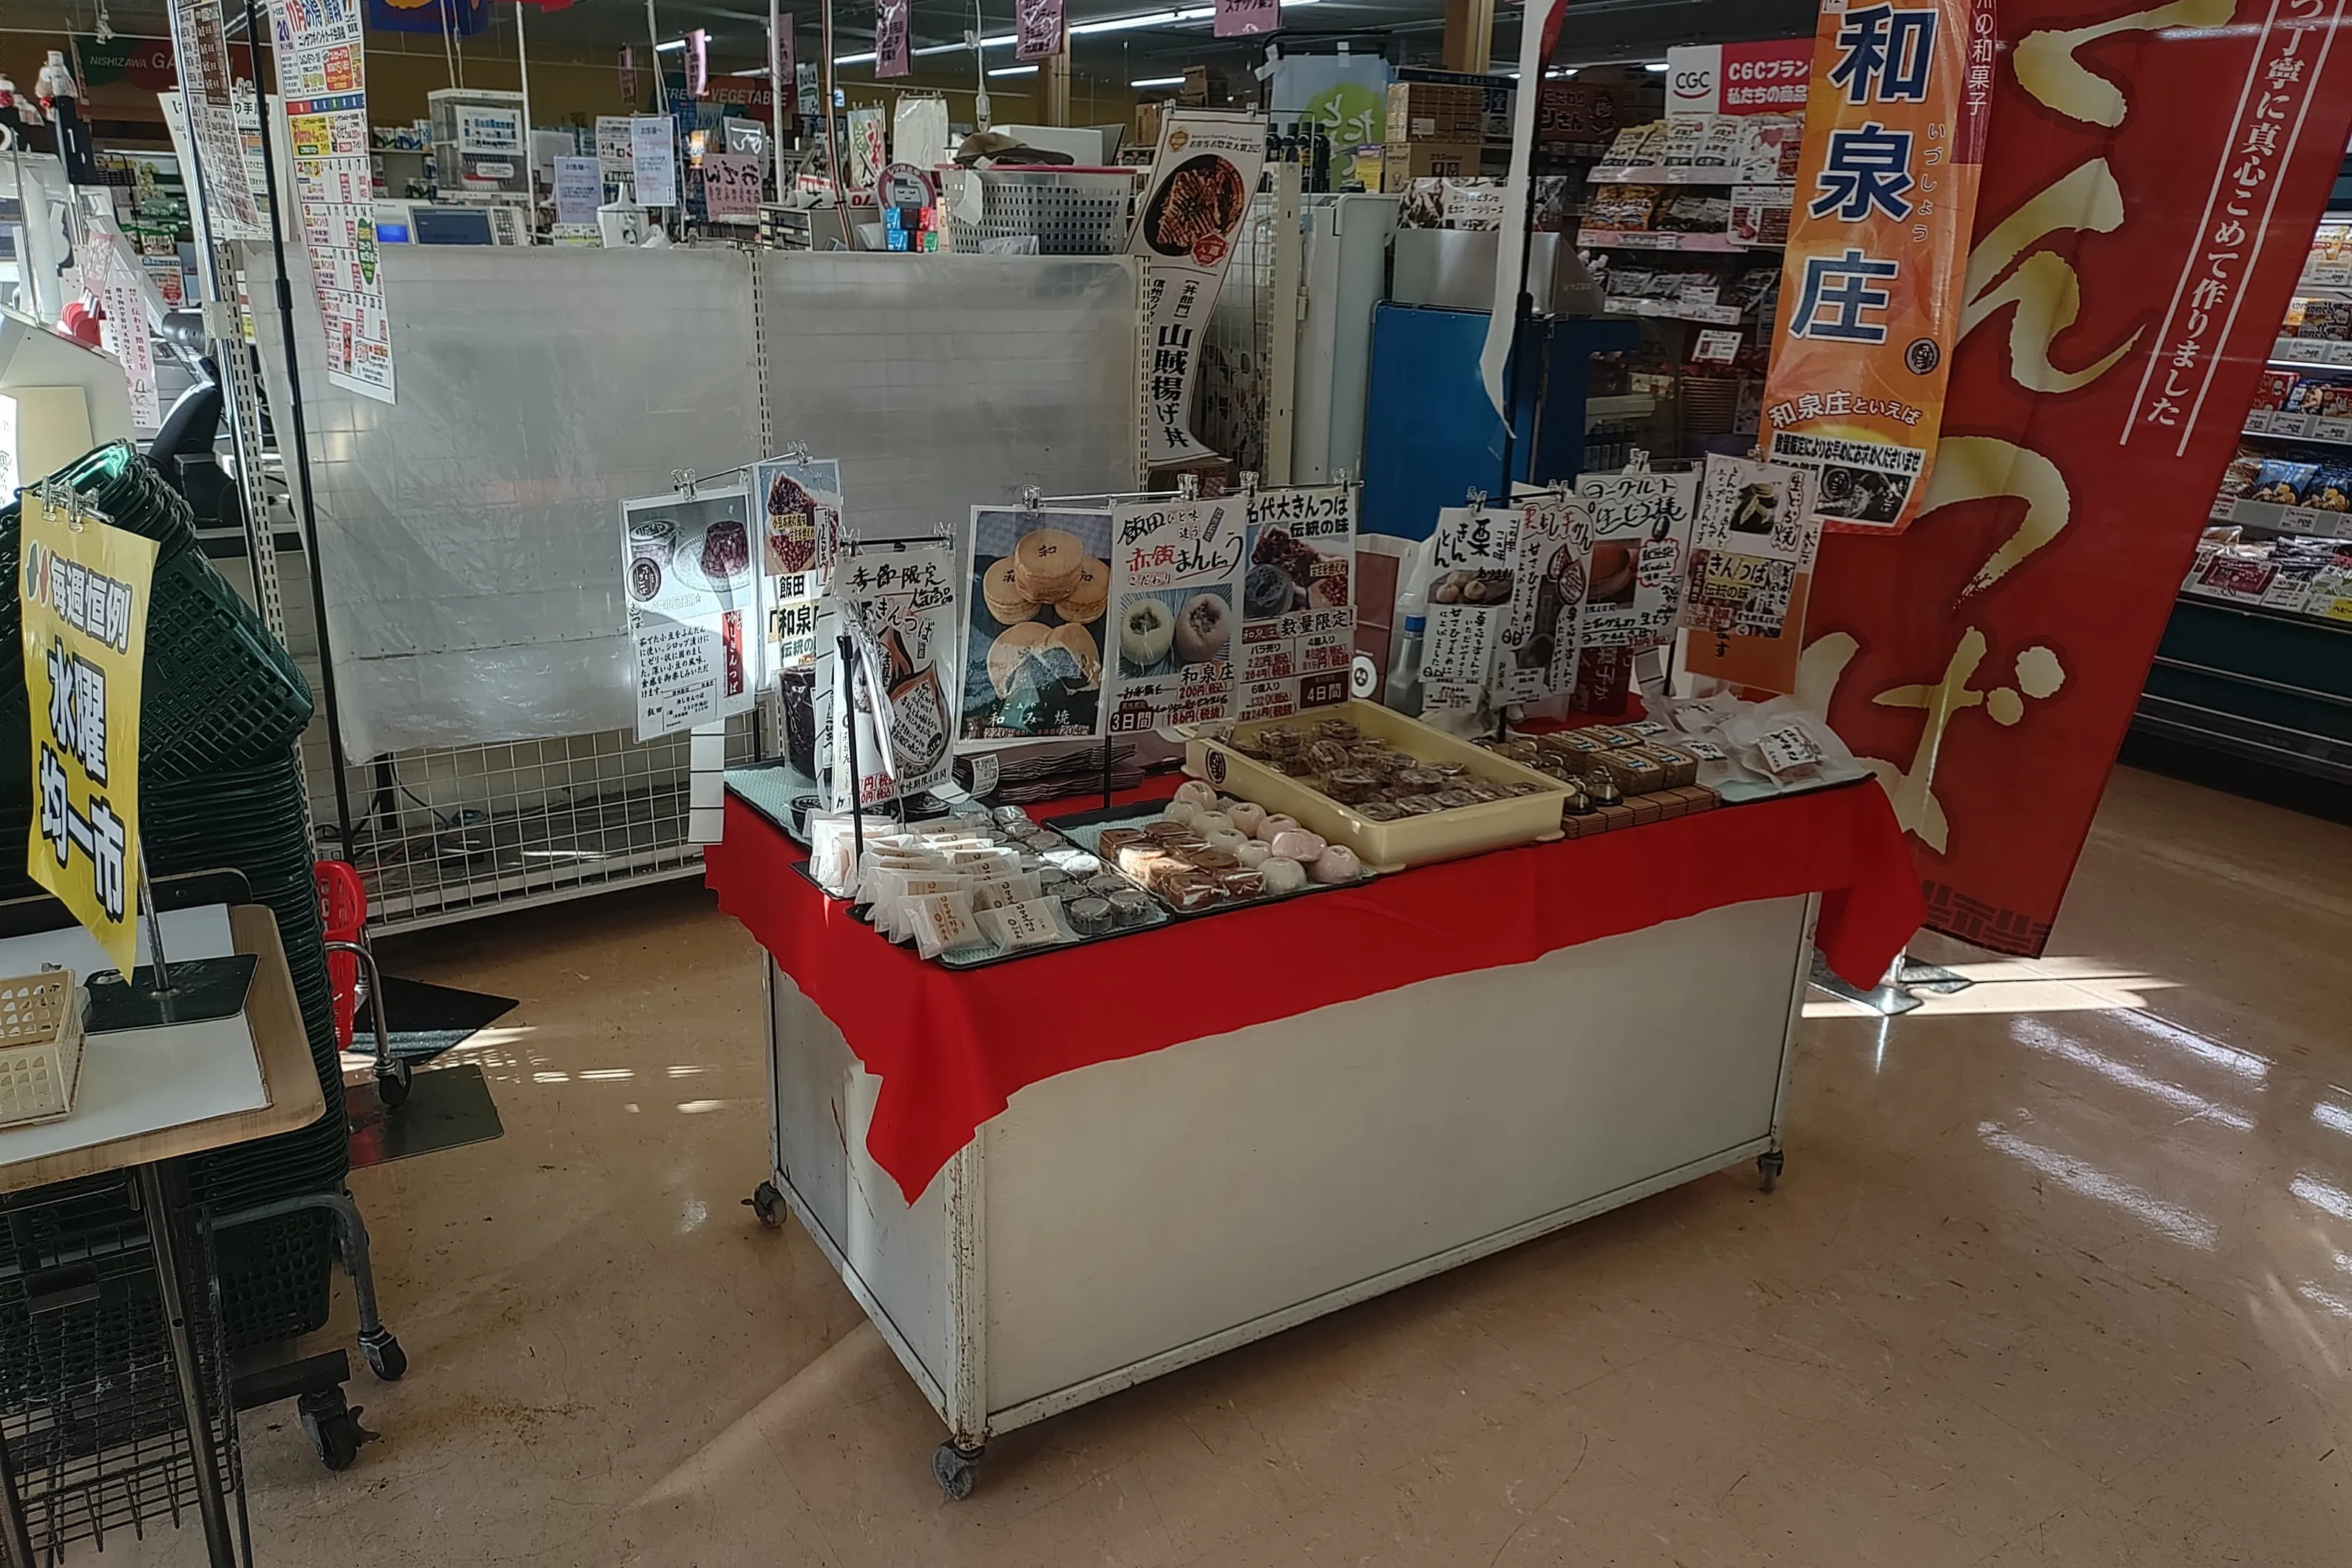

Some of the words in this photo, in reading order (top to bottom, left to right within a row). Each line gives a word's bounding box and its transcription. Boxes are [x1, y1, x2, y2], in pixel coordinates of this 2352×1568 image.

[89, 55, 146, 68] NISHIZAWA
[1728, 60, 1810, 81] CGCブラン
[1675, 72, 1709, 89] CGC
[711, 86, 787, 106] VEGETABE
[1727, 84, 1809, 105] 私たちの商品
[1787, 1, 1939, 345] 和泉庄
[1911, 122, 1945, 244] いづしょう
[1151, 323, 1194, 449] 山賊揚げ丼
[1768, 390, 1923, 430] 和泉庄といえば
[1774, 433, 1920, 473] 数量限定によりお早めにお求めくださいませ
[1775, 474, 1804, 546] 生どら焼
[1117, 512, 1166, 546] 飯田
[1179, 526, 1199, 538] 違う
[1290, 517, 1349, 538] 伝統の味
[1039, 545, 1057, 558] 和
[1129, 573, 1172, 586] こだわり
[1708, 553, 1768, 584] きんつば
[779, 574, 805, 600] 飯田
[49, 554, 134, 652] 毎週恒例
[770, 604, 819, 639] 「和泉
[1281, 609, 1355, 637] 数量限定!
[727, 613, 738, 693] 冷しきんつば
[1251, 643, 1281, 655] バラ売り
[1181, 662, 1236, 686] 和泉庄
[1307, 682, 1342, 702] 4日間
[48, 639, 109, 781] 水曜
[647, 707, 662, 718] 飯田
[989, 710, 1071, 727] 和み焼
[1111, 711, 1151, 730] 3日間
[40, 742, 127, 923] 均一市
